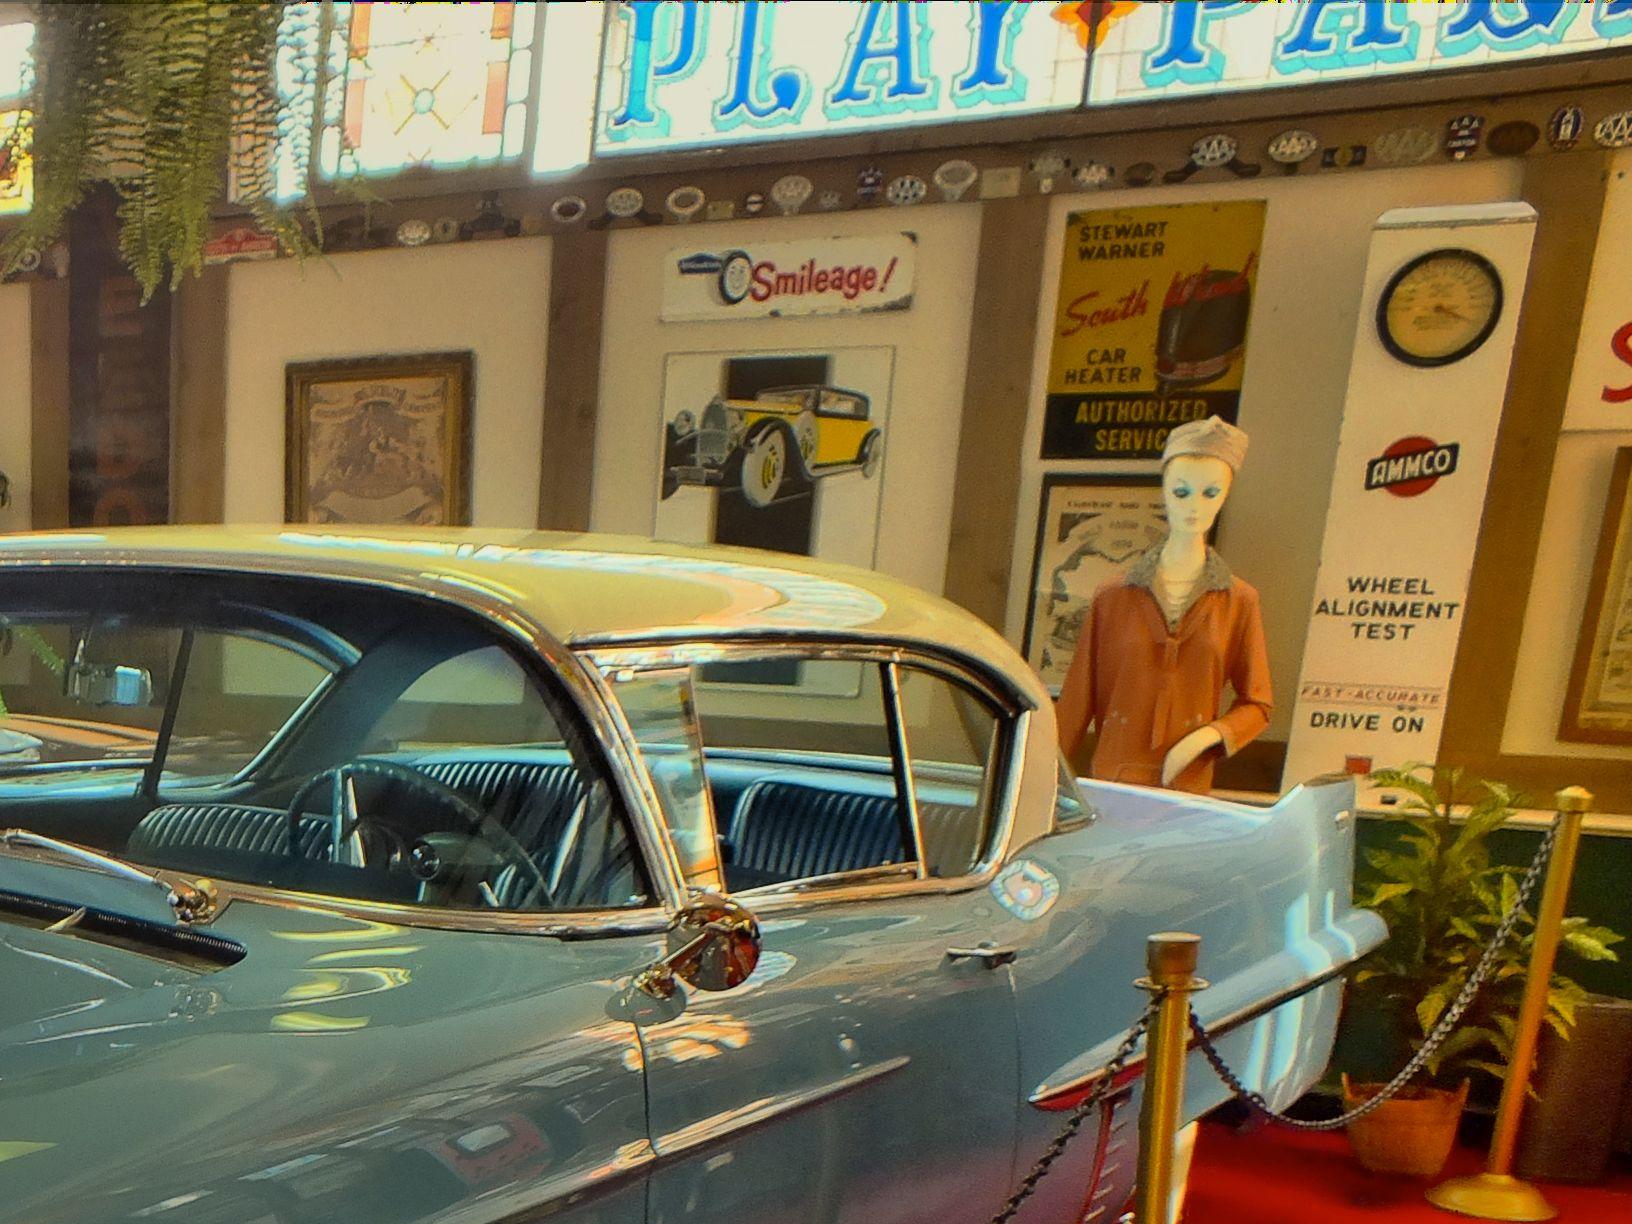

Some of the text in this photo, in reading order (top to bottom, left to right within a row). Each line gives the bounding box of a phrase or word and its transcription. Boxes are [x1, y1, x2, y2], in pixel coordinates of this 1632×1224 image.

[1079, 221, 1168, 243] STEWART
[1077, 241, 1166, 262] WARNER
[750, 256, 899, 302] Smileage!
[1060, 278, 1150, 338] South
[1086, 348, 1127, 366] CAR
[1064, 367, 1143, 385] HEATER
[1075, 400, 1208, 424] AUTHORIZED
[1095, 429, 1167, 451] SERVIC
[1371, 448, 1452, 486] AMMCO
[1347, 576, 1436, 596] WHEEL
[1315, 599, 1460, 620] ALIGNMENT
[1351, 622, 1416, 641] TEST
[1310, 712, 1425, 734] DRIVE ON
